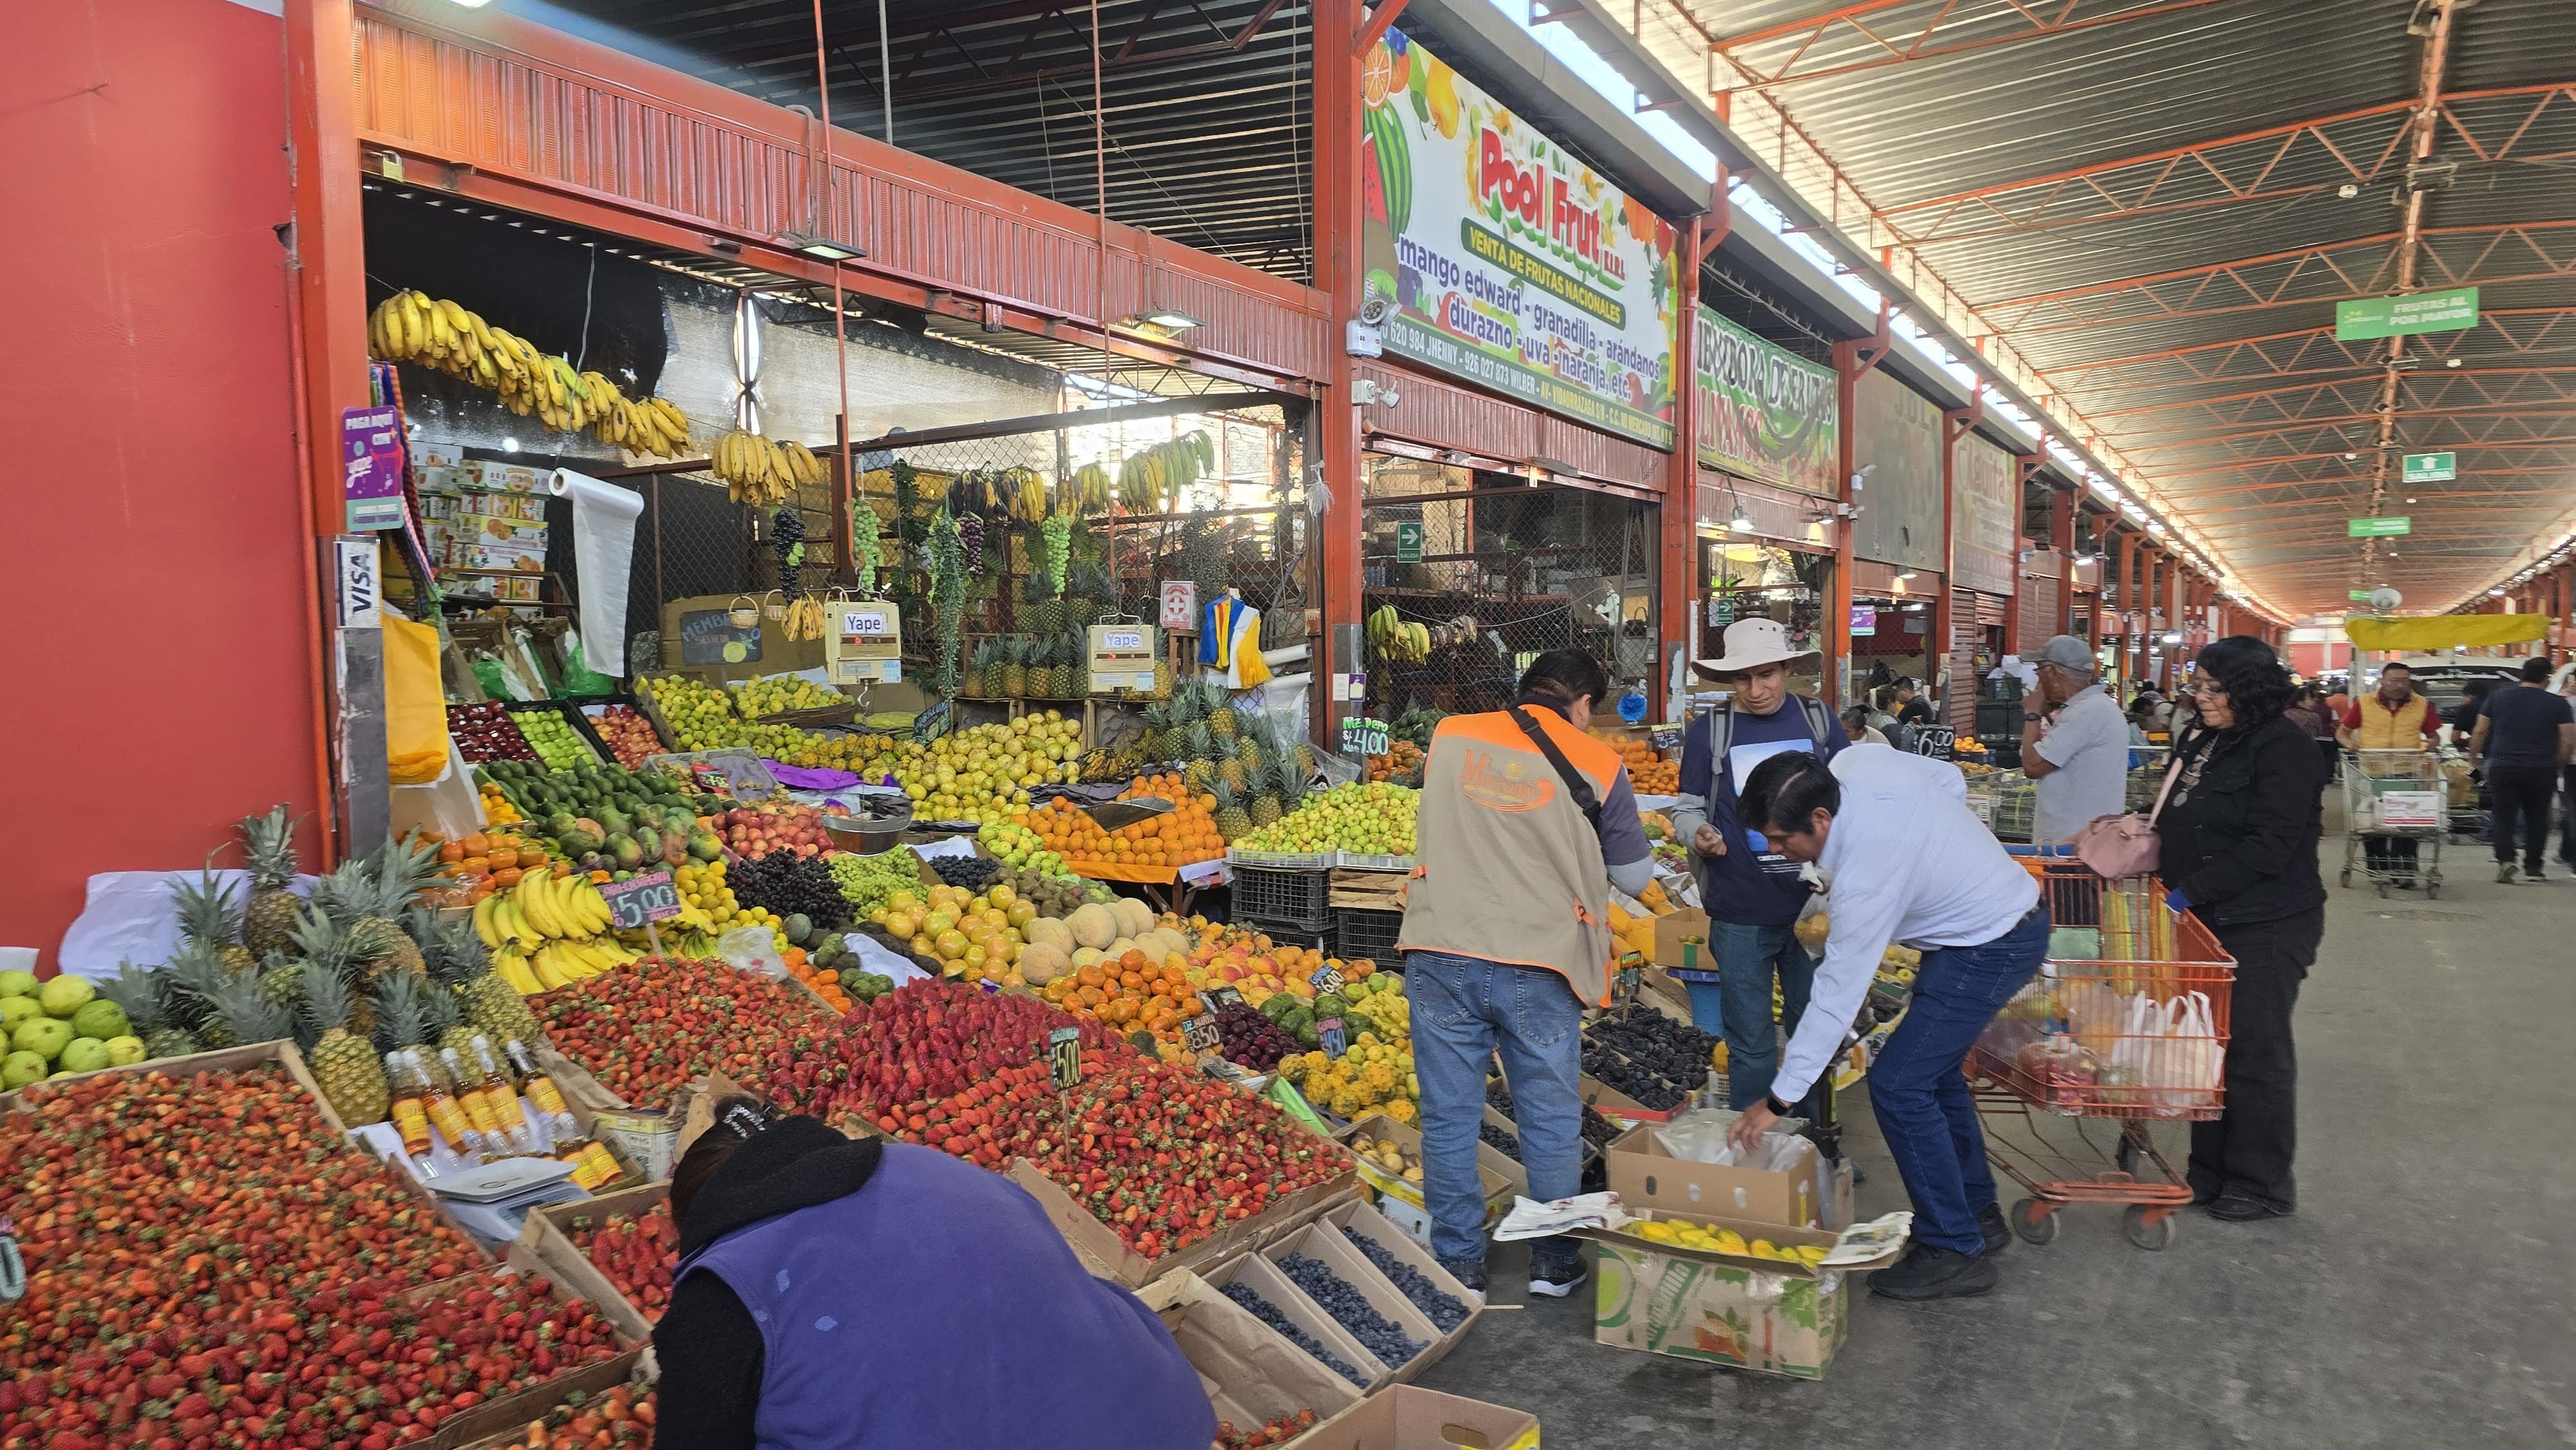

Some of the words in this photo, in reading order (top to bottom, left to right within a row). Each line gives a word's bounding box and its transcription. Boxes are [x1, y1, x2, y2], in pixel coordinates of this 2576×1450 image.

[1481, 127, 1544, 231] Pool
[1552, 175, 1600, 265] Frut
[1469, 226, 1508, 267] VENTA
[1509, 245, 1524, 273] DE
[1525, 256, 1564, 295] FRUTAS
[1565, 279, 1621, 325] NACIONALES
[1399, 236, 1460, 288] mango
[1464, 268, 1521, 317] edward
[1533, 304, 1596, 352] granadilla
[1605, 338, 1660, 381] arándanos
[2389, 314, 2420, 326] POR
[2420, 308, 2474, 323] MAYOR
[2393, 299, 2448, 314] FRUTAS
[2448, 296, 2469, 307] AL
[1390, 321, 1407, 346] 620
[1408, 330, 1425, 353] 984
[1426, 335, 1458, 366] JHENNY
[1464, 350, 1479, 374] 926
[1481, 357, 1494, 380] 027
[1495, 362, 1509, 385] 873
[1510, 368, 1536, 395] WILBER
[1449, 297, 1513, 350] durazno
[1526, 336, 1550, 366] uva
[1562, 350, 1609, 395] naranja,
[1611, 371, 1632, 399] etc.
[345, 416, 370, 431] PAGA
[350, 553, 372, 614] VISA
[847, 616, 881, 634] Yape
[1106, 634, 1139, 647] Yape
[1353, 728, 1389, 755] 4.00
